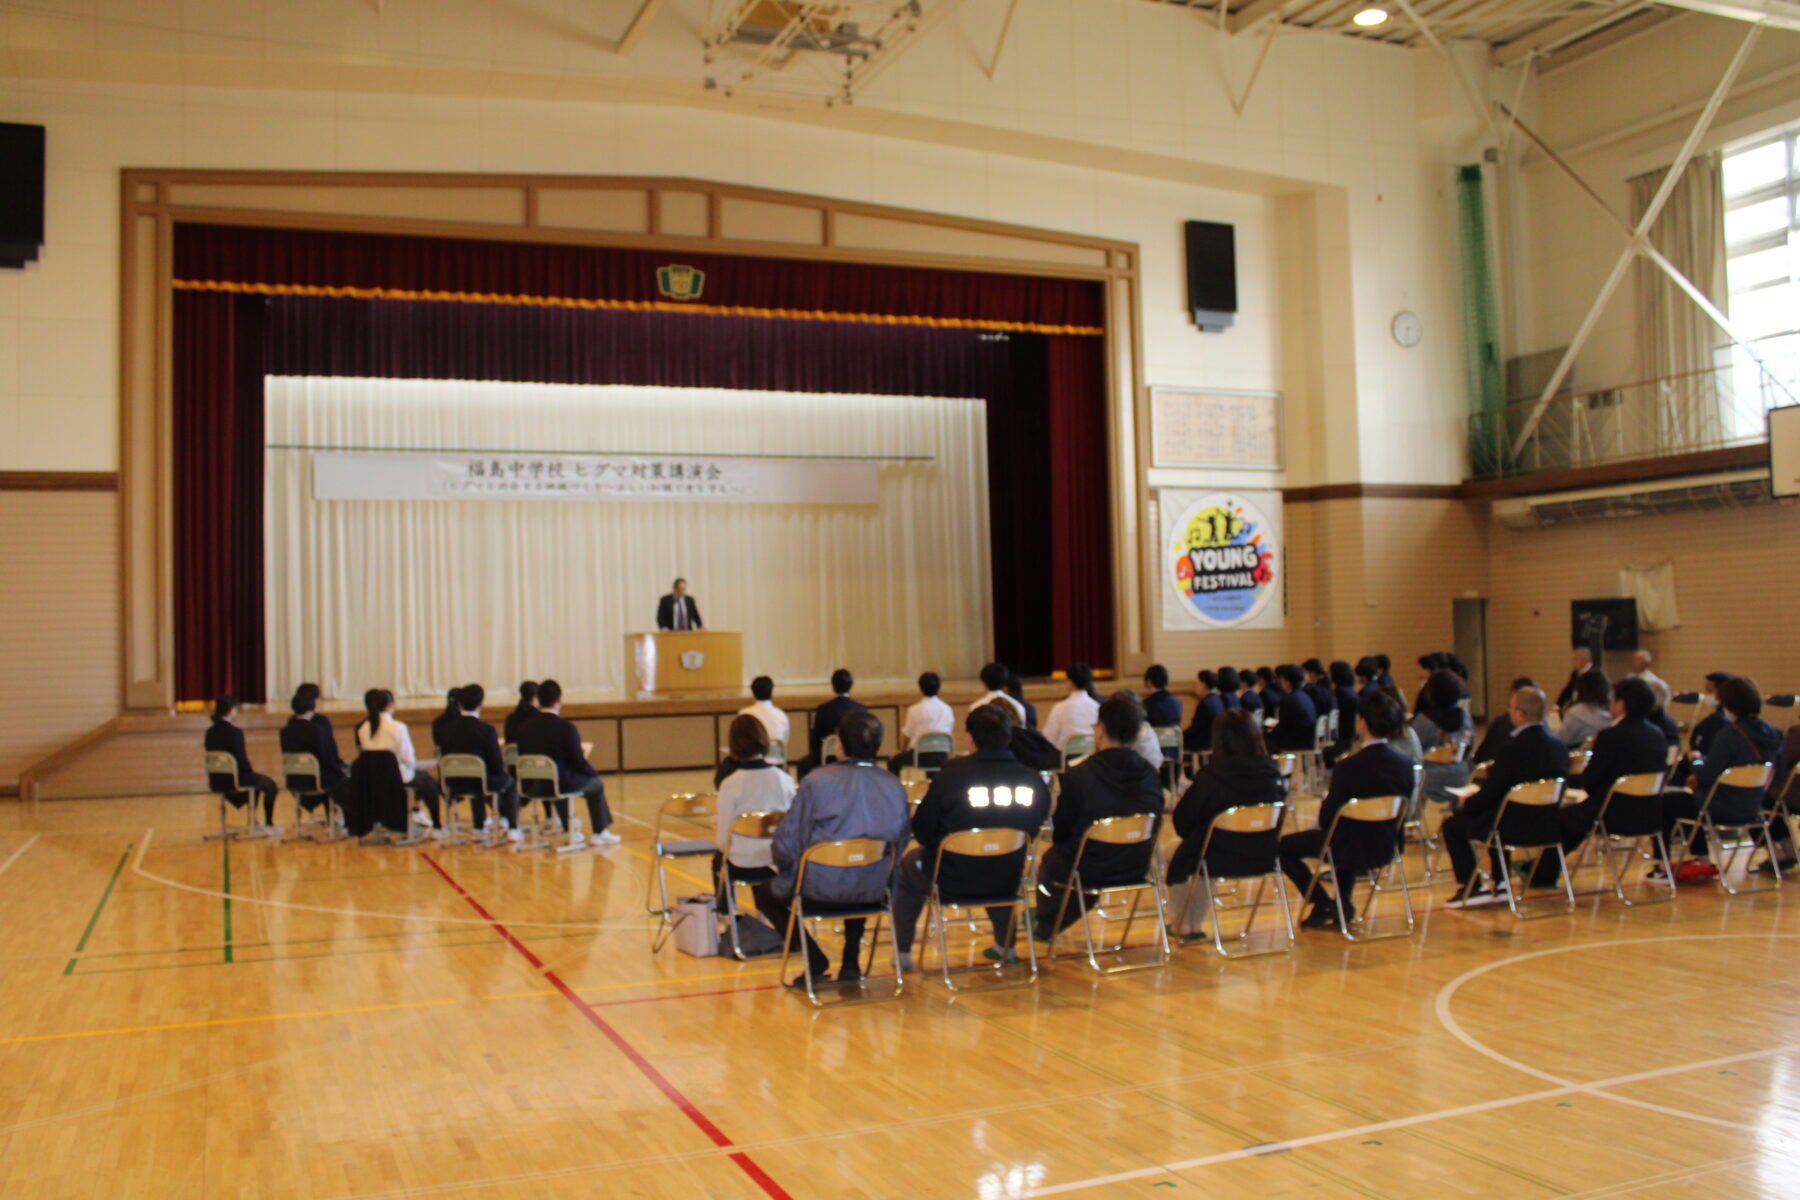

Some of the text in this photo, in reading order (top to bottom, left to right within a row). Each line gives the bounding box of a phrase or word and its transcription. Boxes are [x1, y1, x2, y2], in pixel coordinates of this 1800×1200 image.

[468, 460, 722, 481] 福島中学校 ヒグマ対策講演会
[1190, 545, 1258, 571] YOUNG
[1192, 571, 1256, 590] FESTIVAL
